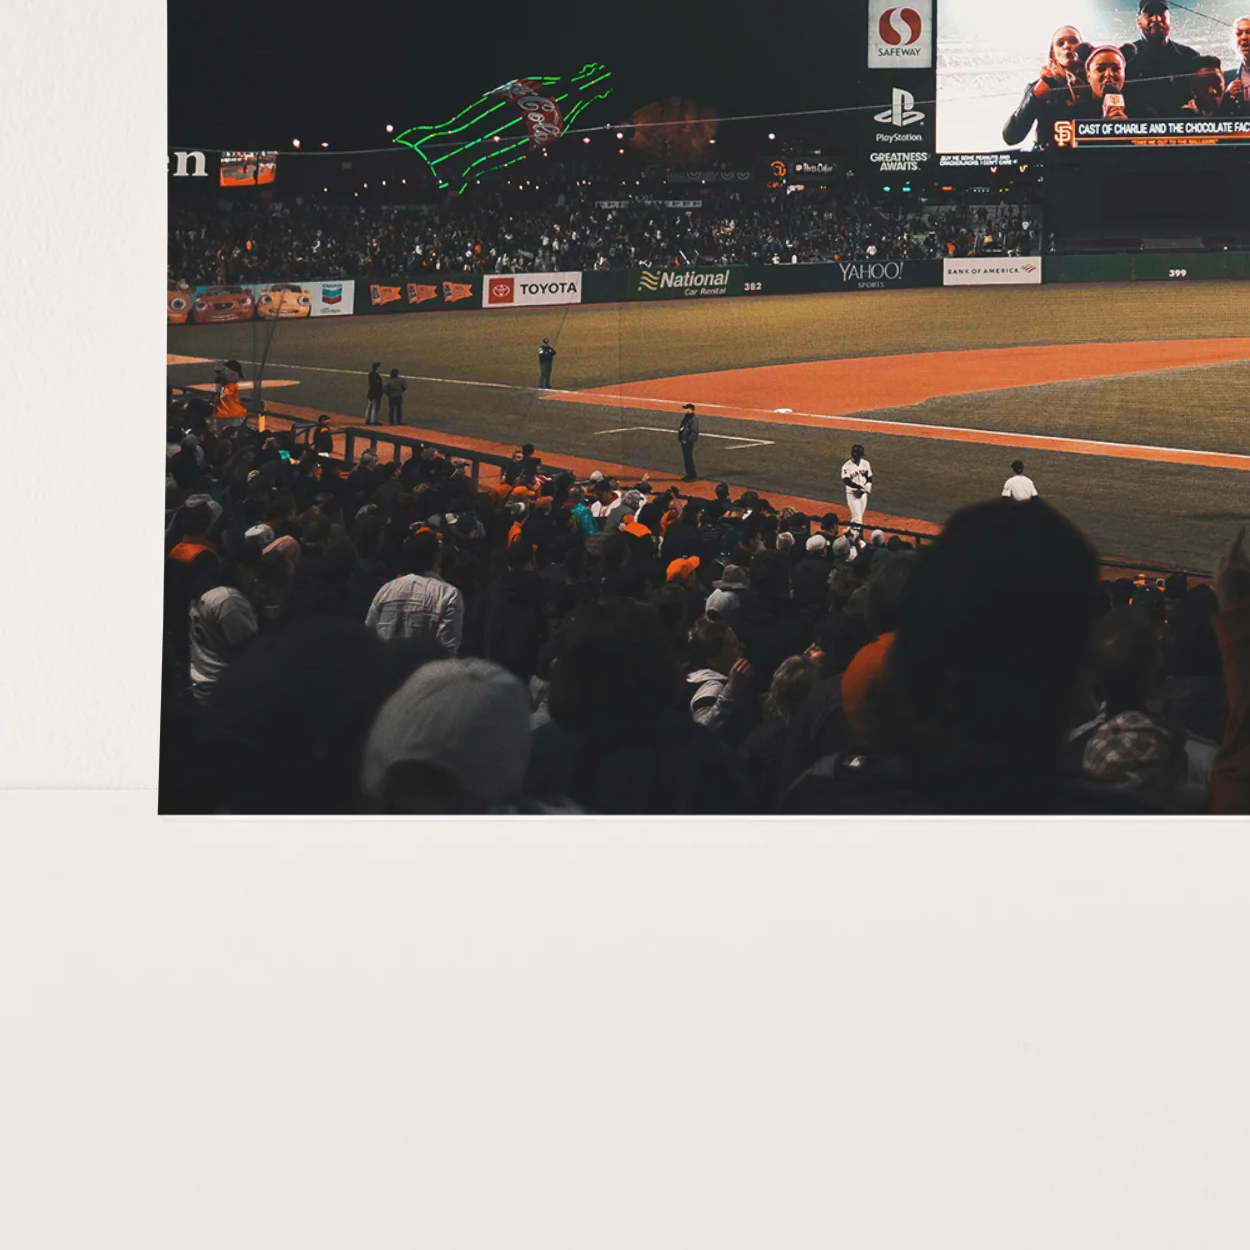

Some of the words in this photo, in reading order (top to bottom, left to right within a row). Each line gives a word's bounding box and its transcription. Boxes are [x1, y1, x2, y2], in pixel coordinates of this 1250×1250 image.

[877, 47, 922, 58] SAFEWAY
[1078, 123, 1100, 135] CAST
[1102, 123, 1114, 135] OF
[1115, 123, 1148, 135] CHARLIE
[1149, 122, 1167, 134] AND
[1169, 122, 1185, 134] THE
[1186, 121, 1234, 134] CHOCOLATE
[876, 132, 923, 143] PlayStation
[870, 152, 928, 162] GREATNESS
[168, 150, 209, 177] n
[839, 261, 905, 282] YAHOO!
[1168, 268, 1187, 278] 399
[659, 269, 730, 288] National
[519, 282, 578, 296] TOYOTA
[743, 281, 762, 292] 382
[857, 281, 885, 289] SPORTS
[683, 287, 699, 297] Car
[700, 287, 727, 296] Rental
